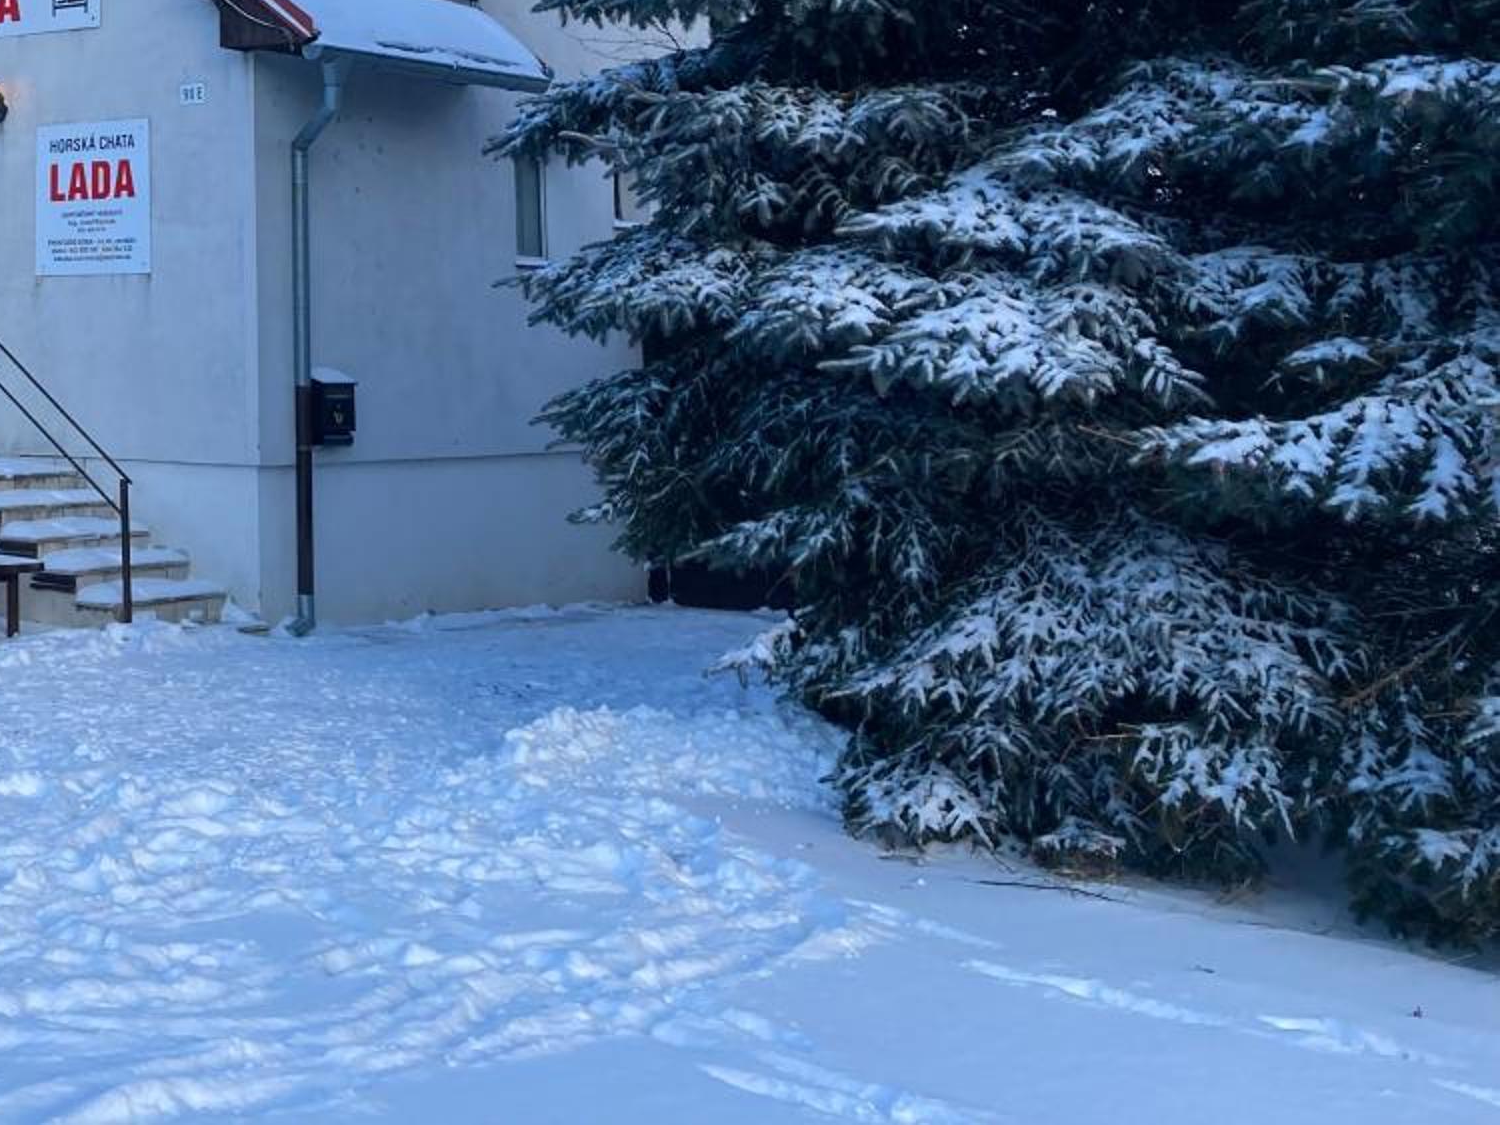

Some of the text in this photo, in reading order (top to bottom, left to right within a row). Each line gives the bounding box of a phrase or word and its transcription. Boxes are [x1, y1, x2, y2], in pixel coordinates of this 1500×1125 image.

[49, 133, 135, 154] HORSKÁ CHATA
[50, 159, 135, 202] LADA
